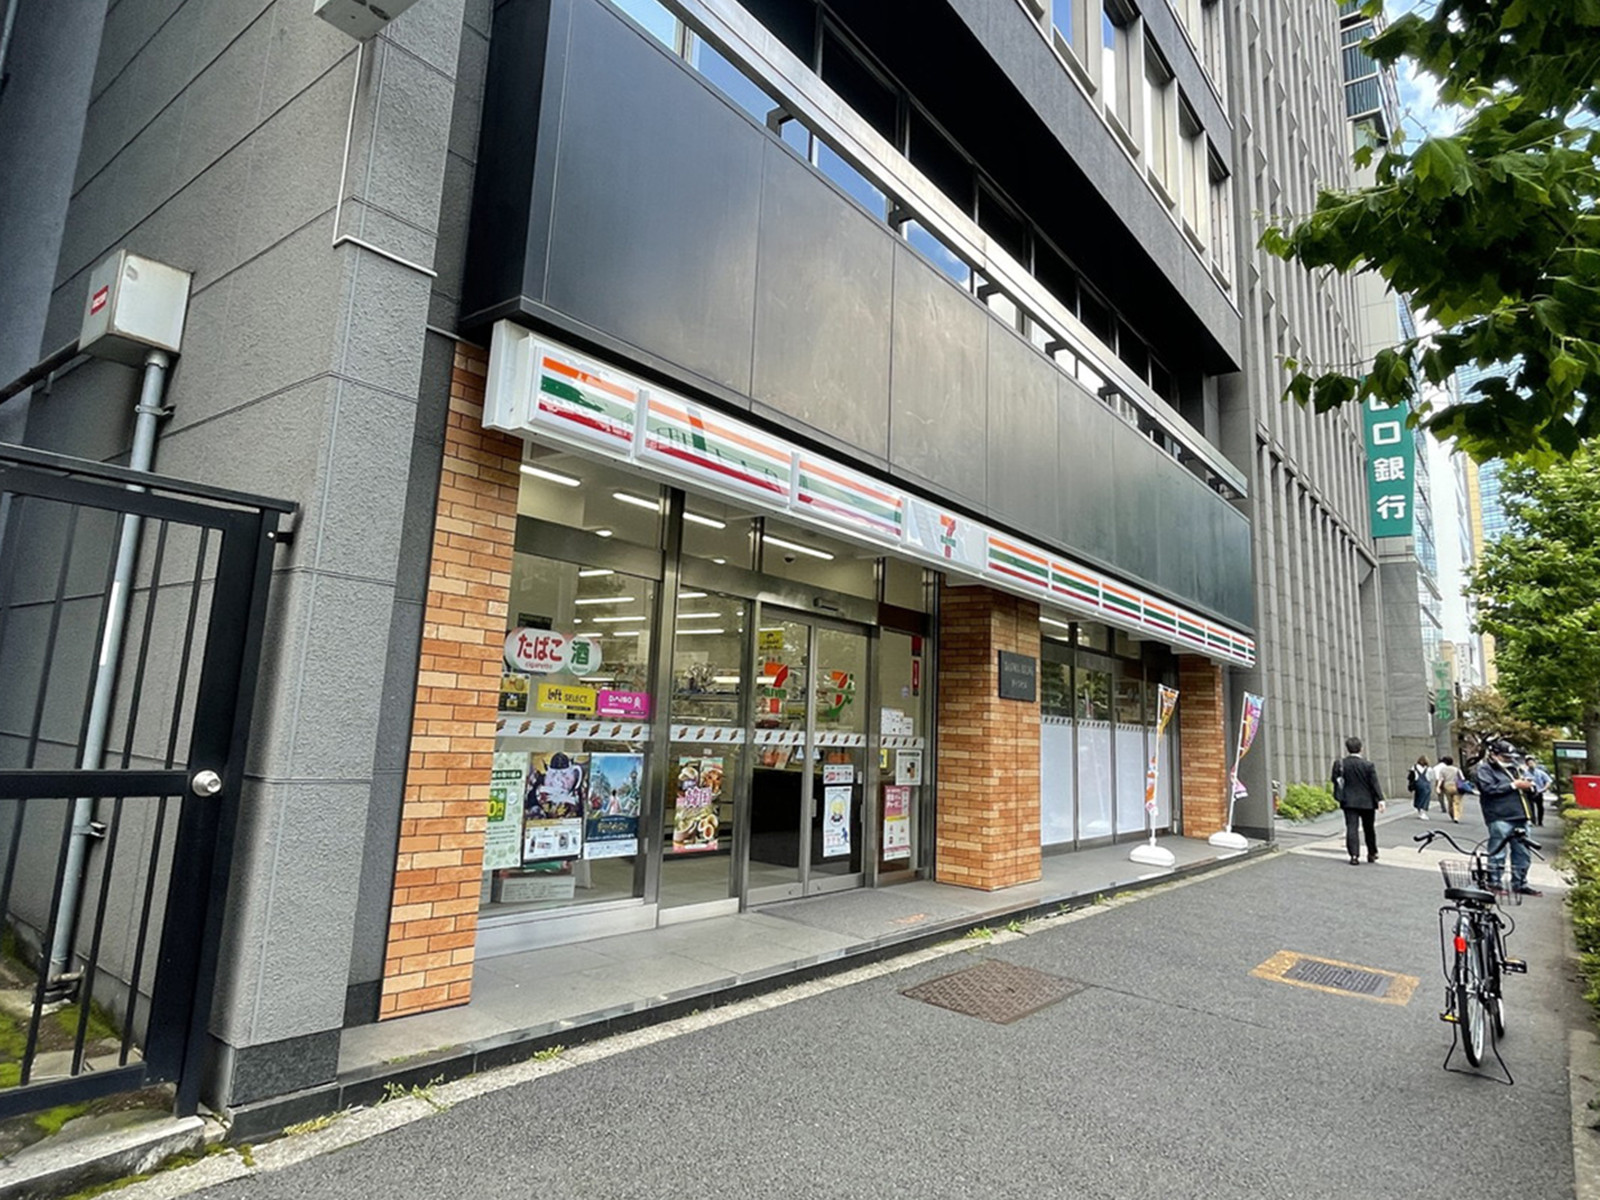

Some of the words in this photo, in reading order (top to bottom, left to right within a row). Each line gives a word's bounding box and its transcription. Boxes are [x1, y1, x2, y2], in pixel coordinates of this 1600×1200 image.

[517, 633, 563, 662] たばこ
[571, 640, 591, 665] 酒
[564, 693, 588, 704] SELECT
[608, 695, 633, 704] DAISO
